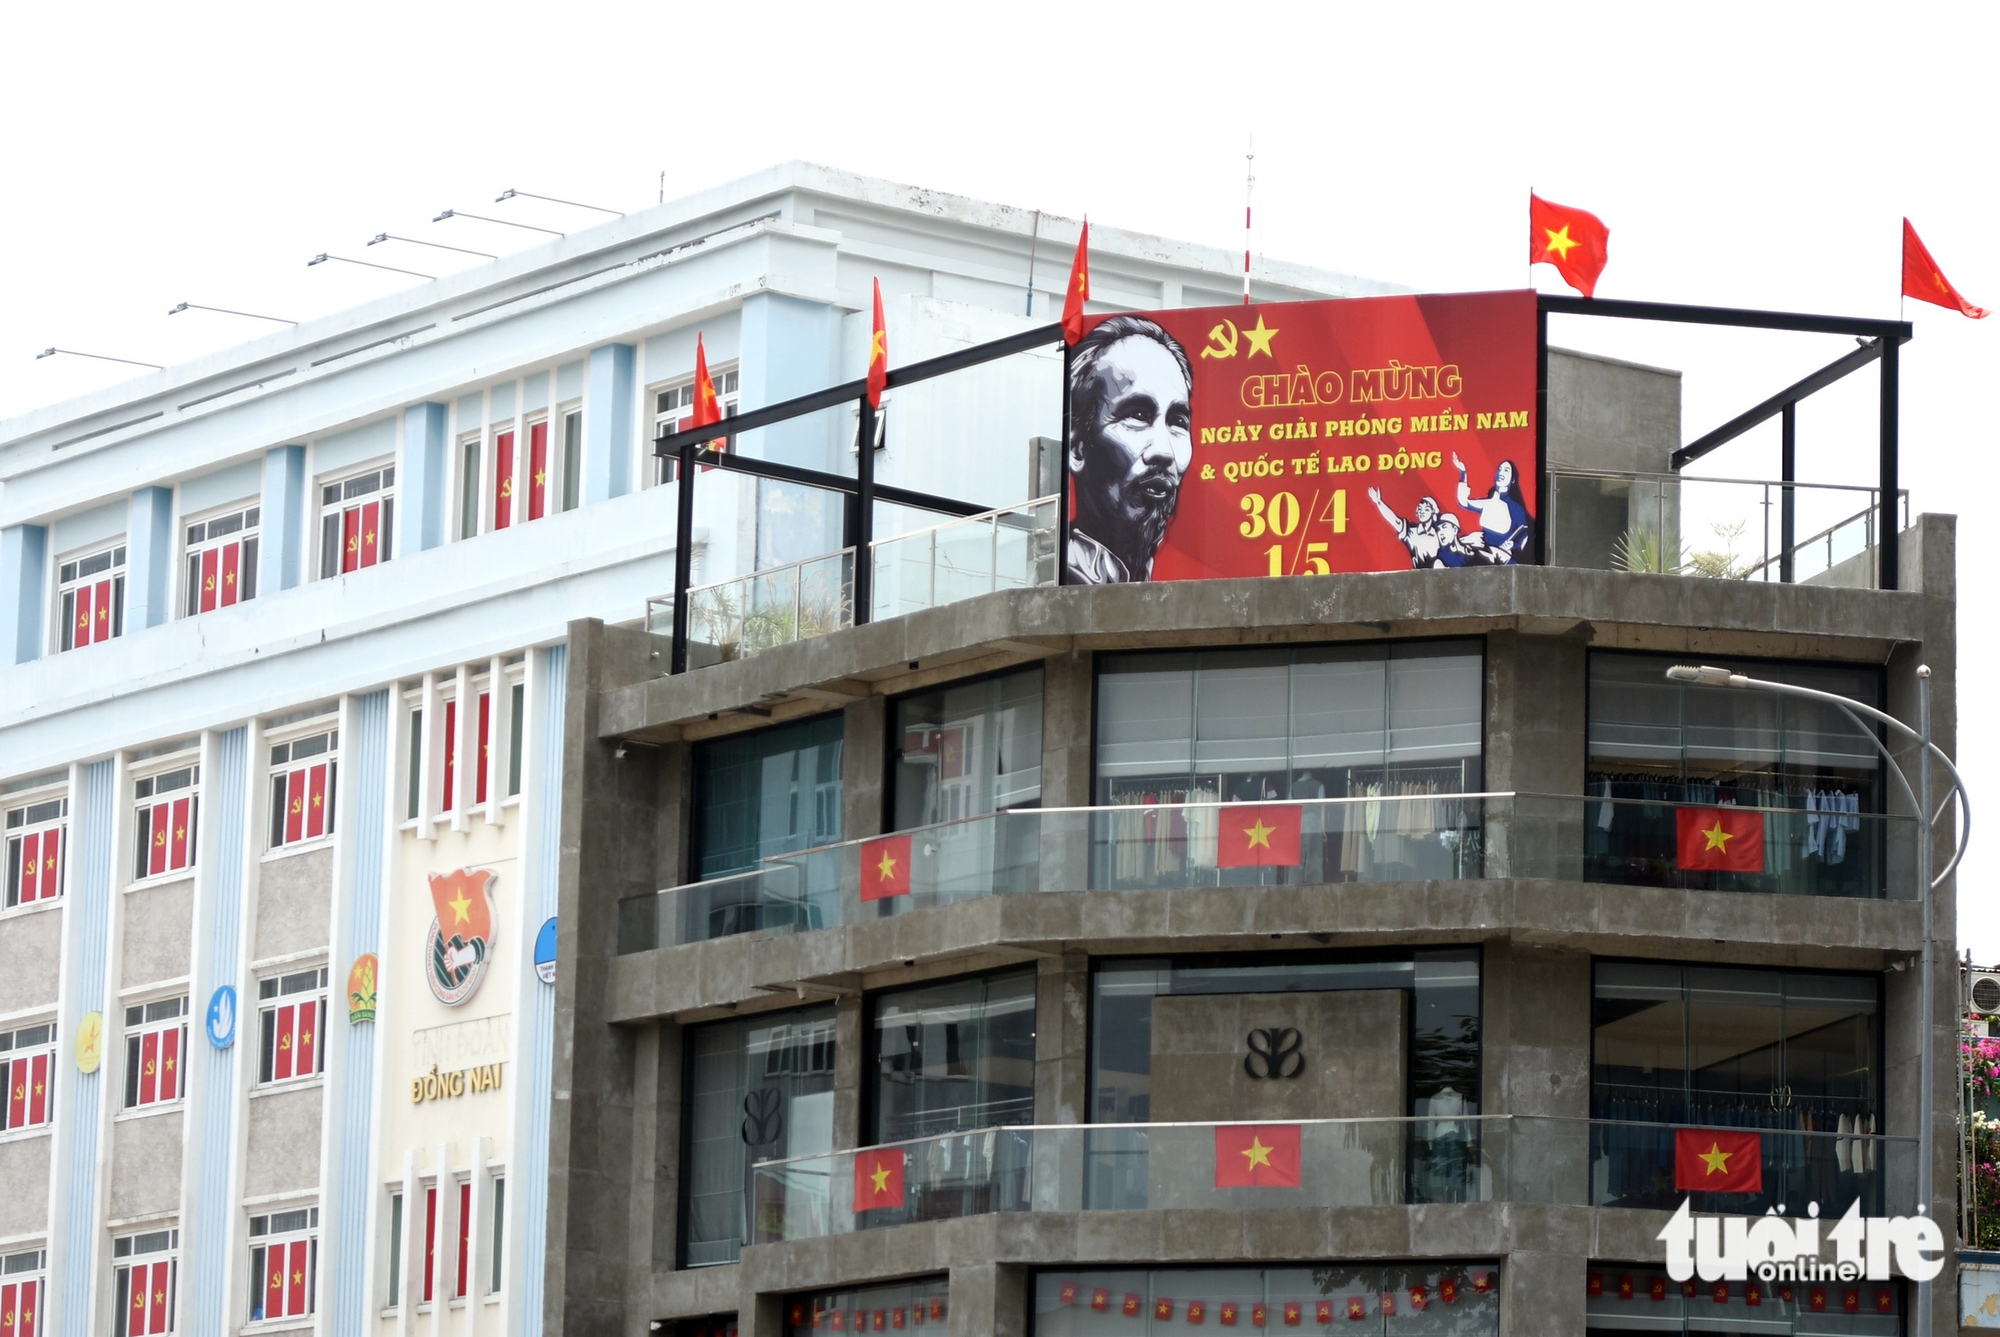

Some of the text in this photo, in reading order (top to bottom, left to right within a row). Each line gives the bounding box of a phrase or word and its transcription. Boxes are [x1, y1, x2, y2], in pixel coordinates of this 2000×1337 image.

[1241, 359, 1462, 408] CHÀO MỪNG
[1200, 407, 1529, 444] NGÀY GIẢI PHÓNG MIỀN NAM
[1200, 447, 1442, 483] & QUỐC TẾ LAO ĐỘNG
[1240, 489, 1350, 539] 30/4
[1264, 542, 1331, 577] 1/5
[412, 1062, 503, 1104] ĐỒNG NAI
